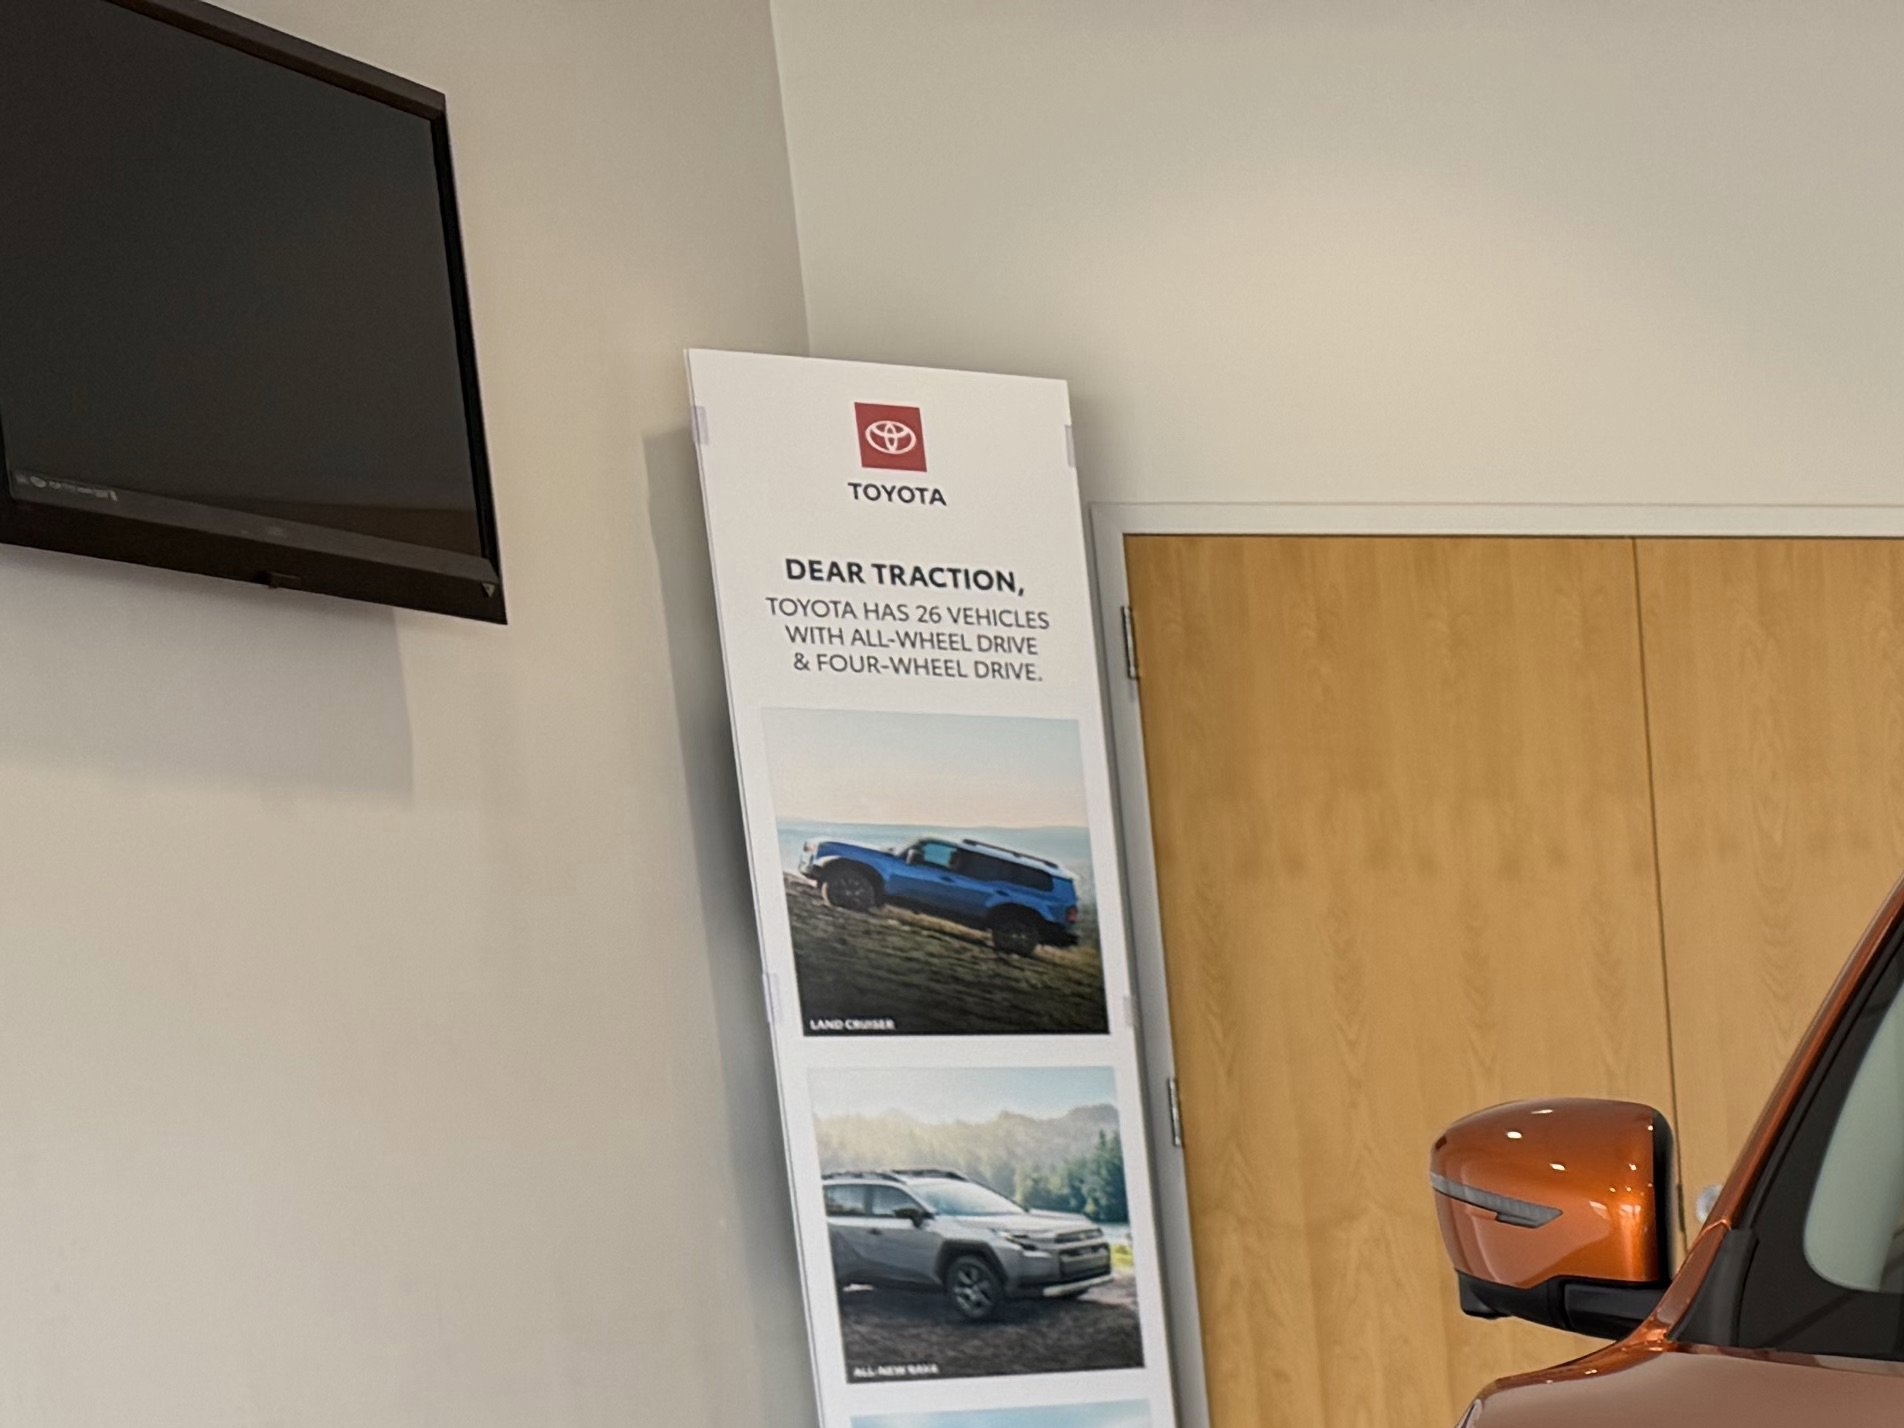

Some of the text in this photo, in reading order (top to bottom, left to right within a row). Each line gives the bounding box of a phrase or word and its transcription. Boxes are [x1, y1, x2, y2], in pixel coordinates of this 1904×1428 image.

[847, 481, 947, 506] TOYOTA
[785, 558, 1024, 597] DEAR TRACTION,
[765, 597, 1050, 630] TOYOTA HAS 26 VEHICLES
[785, 625, 1039, 656] WITH ALL-WHEEL DRIVE
[793, 652, 1043, 682] & FOUR-WHEEL DRIVE.
